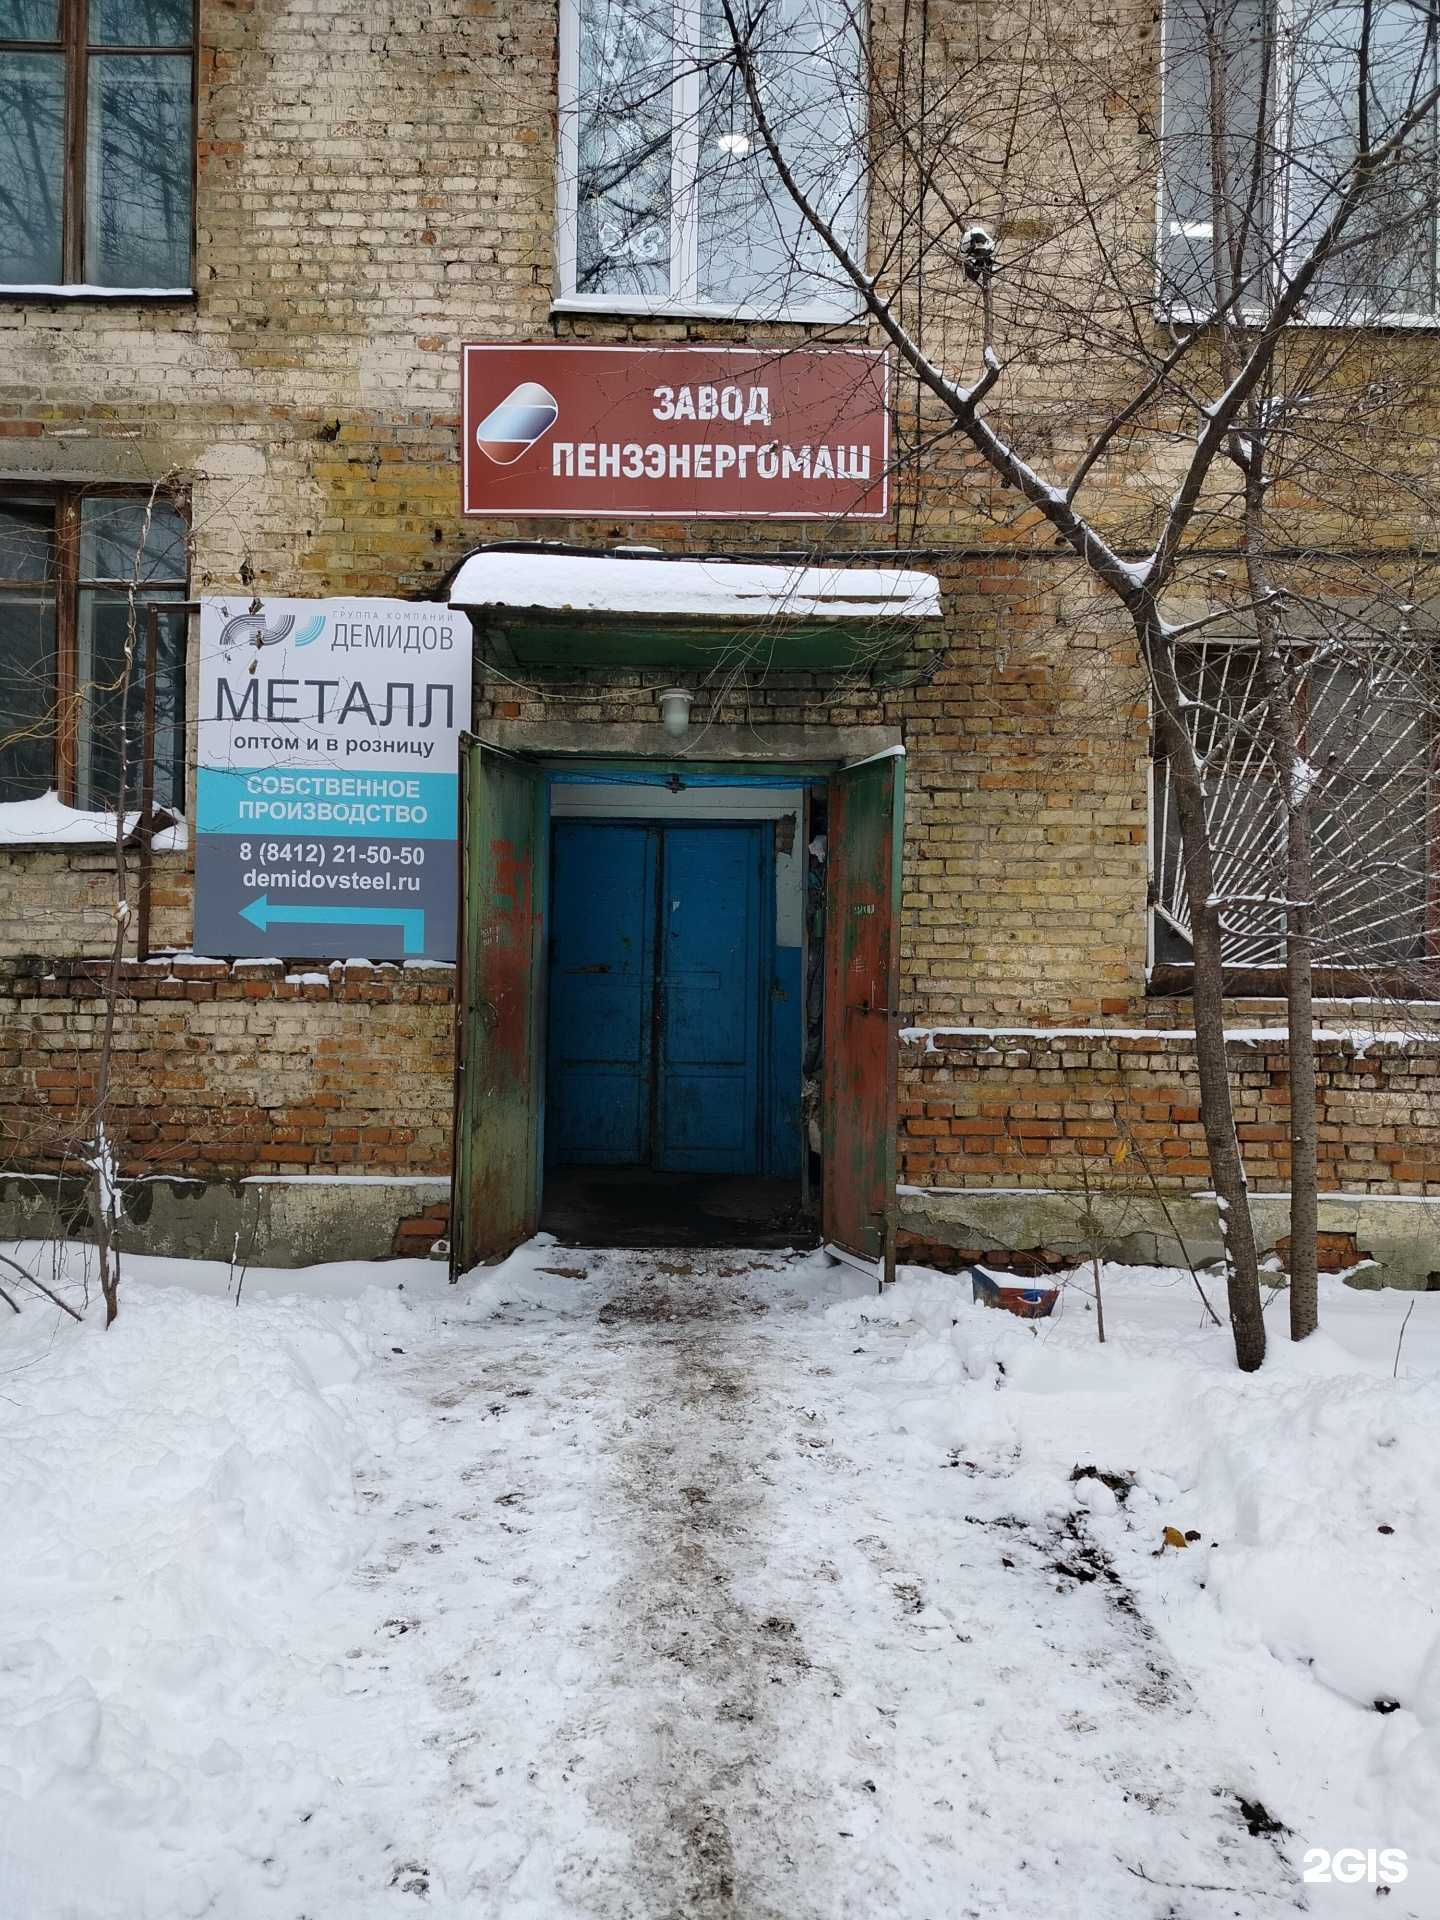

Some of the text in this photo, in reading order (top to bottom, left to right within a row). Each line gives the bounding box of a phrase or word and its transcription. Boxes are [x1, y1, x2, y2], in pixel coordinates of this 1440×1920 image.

[653, 385, 772, 425] ЗАВОД
[552, 442, 870, 479] ПЕНЗЭНЕРГОМАШ
[332, 610, 379, 619] ГРУППА
[331, 623, 454, 654] ДЕМИДОВ
[216, 677, 454, 729] МЕТАЛЛ
[234, 736, 435, 758] оптом и в розницу
[247, 775, 420, 798] СОБСТВЕННОЕ
[239, 800, 428, 824] ПРОИЗВОДСТВО
[239, 842, 425, 867] 8 (8412) 21-50-50
[243, 868, 421, 892] demidovsteel.ru
